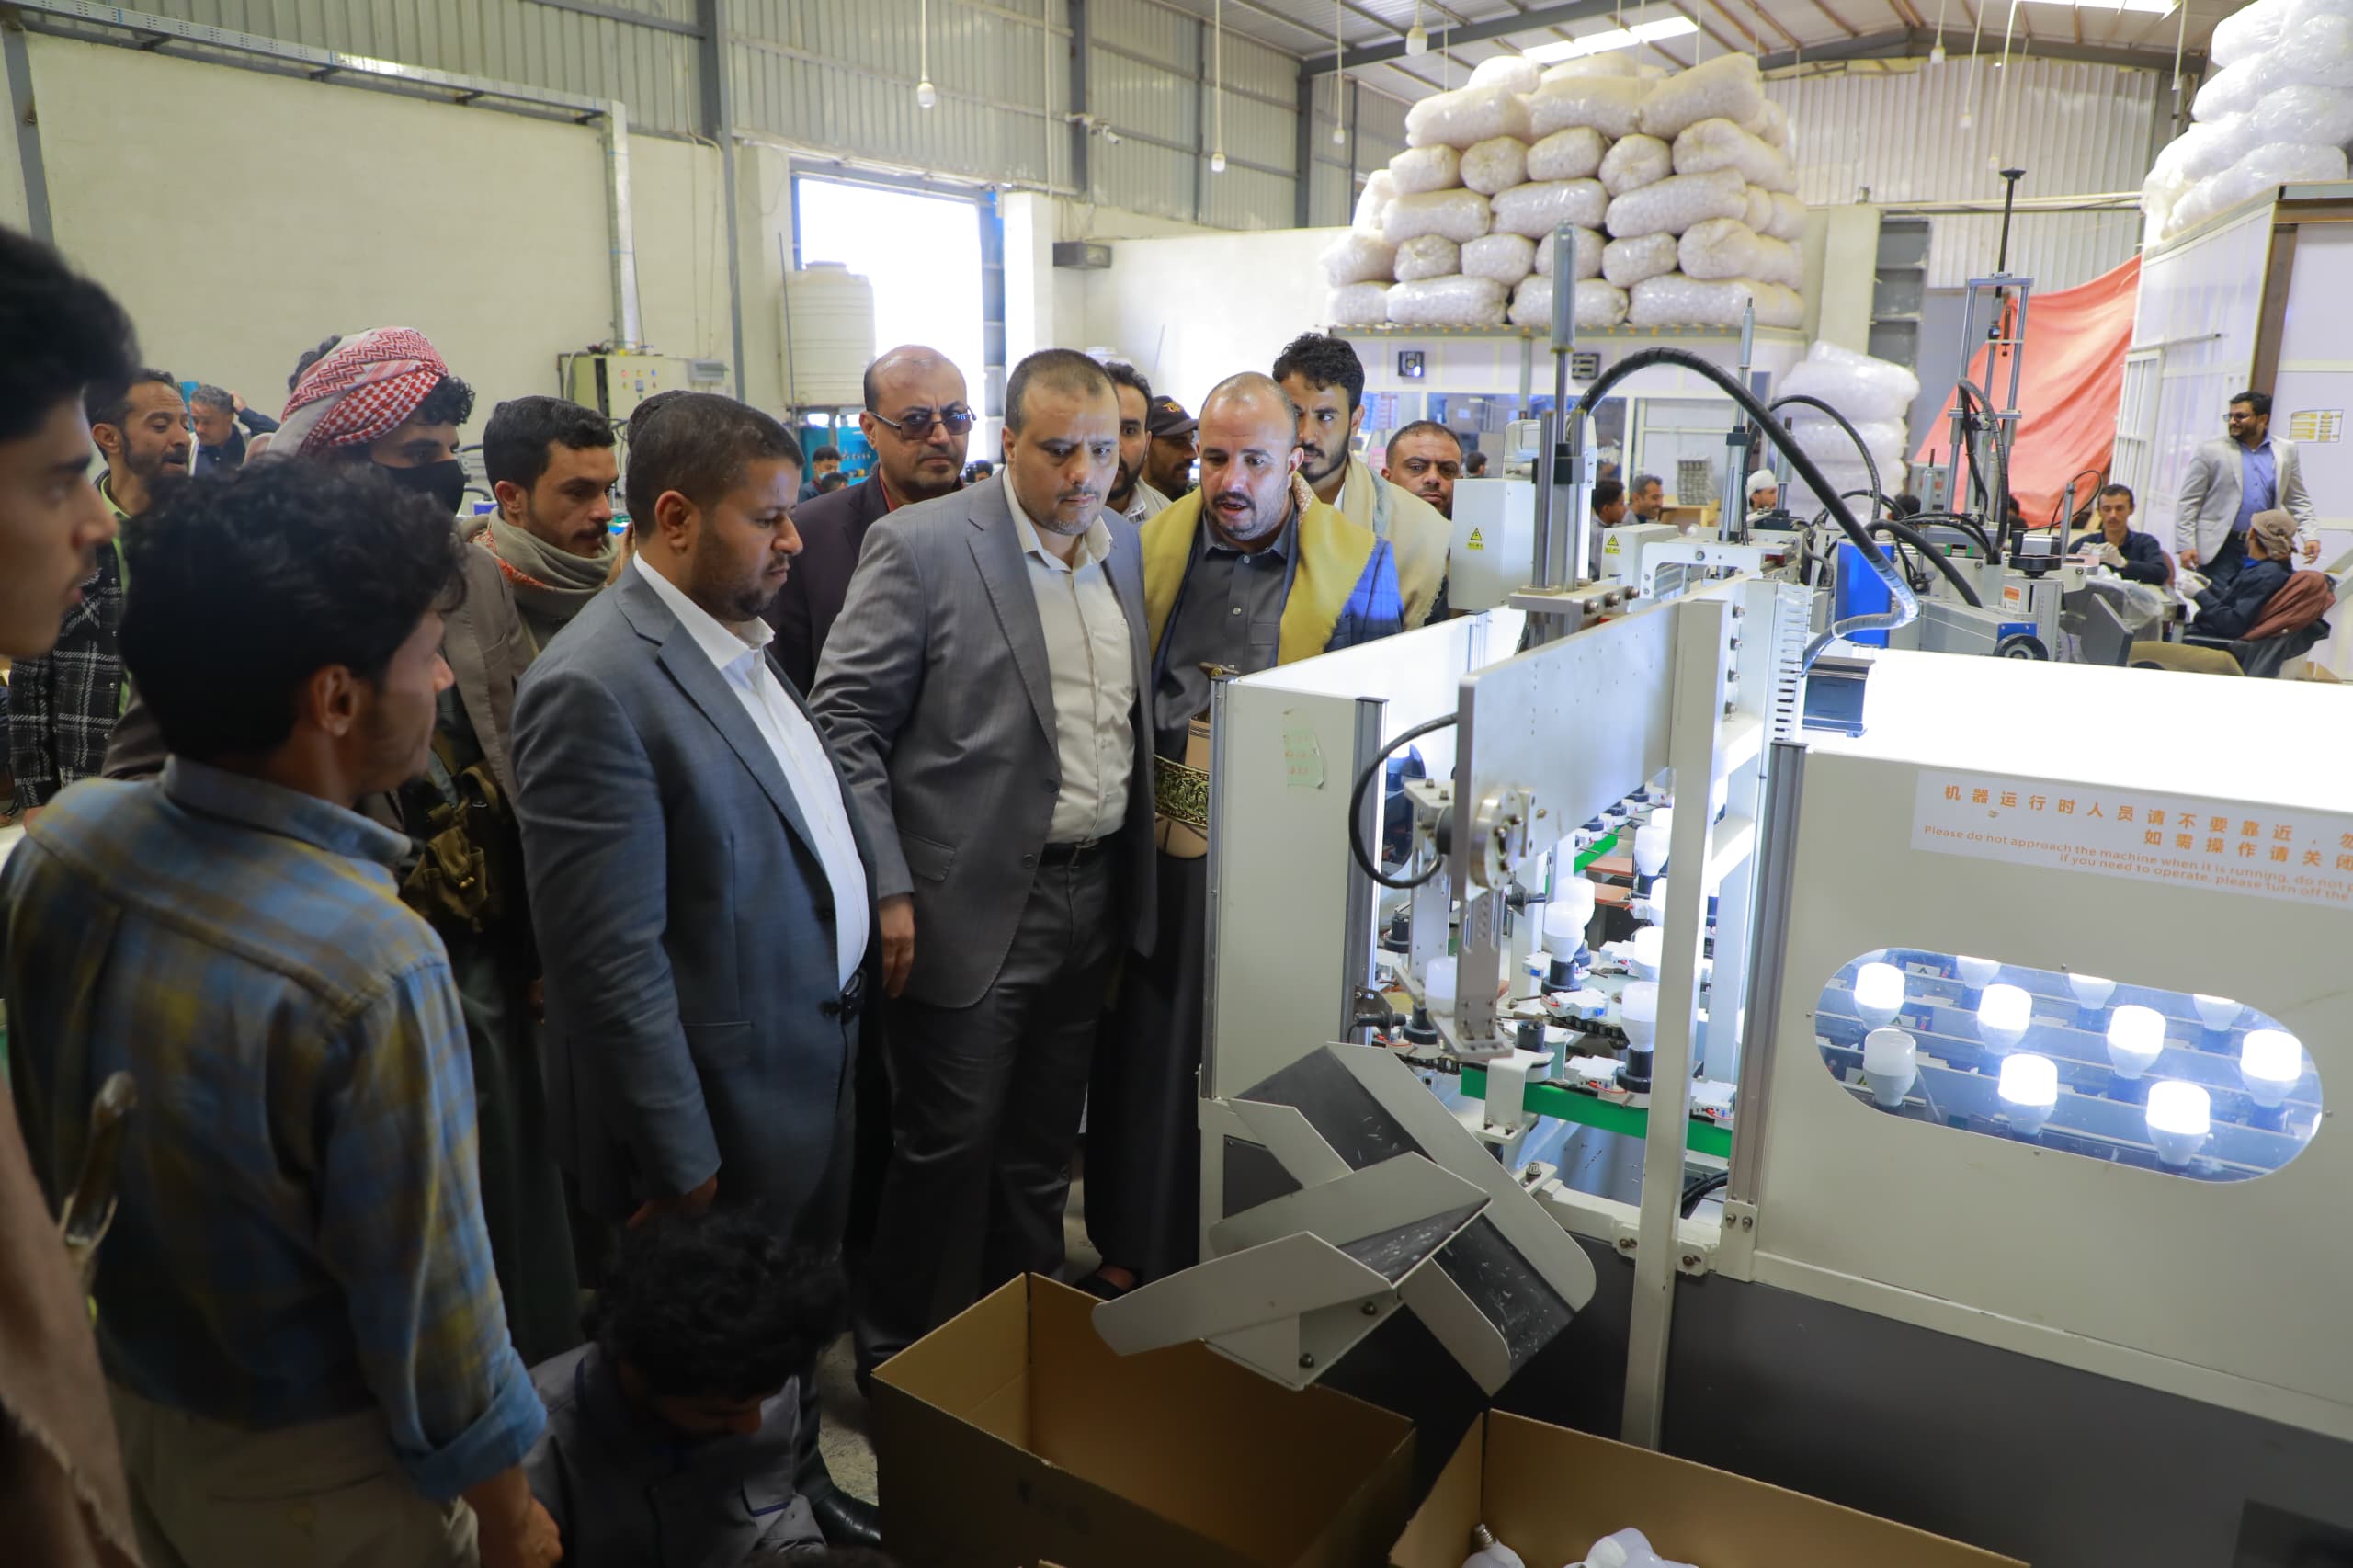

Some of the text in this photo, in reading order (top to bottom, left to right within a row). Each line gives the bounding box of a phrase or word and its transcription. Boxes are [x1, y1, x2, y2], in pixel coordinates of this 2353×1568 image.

[1925, 824, 1964, 839] Please
[1966, 830, 1983, 841] do
[1985, 834, 2007, 845] not
[2010, 837, 2072, 854] approach
[2075, 845, 2097, 856] the
[2100, 849, 2158, 864] machine
[2161, 857, 2198, 869] when
[2201, 860, 2211, 871] it
[2215, 865, 2226, 873] is
[2294, 874, 2313, 885] do
[2317, 878, 2344, 890] not
[2072, 856, 2096, 866] you
[2099, 860, 2133, 871] need
[2136, 864, 2151, 874] to
[2215, 874, 2262, 890] please
[2265, 881, 2296, 893] turn
[2300, 886, 2322, 897] off
[2325, 890, 2349, 902] the
